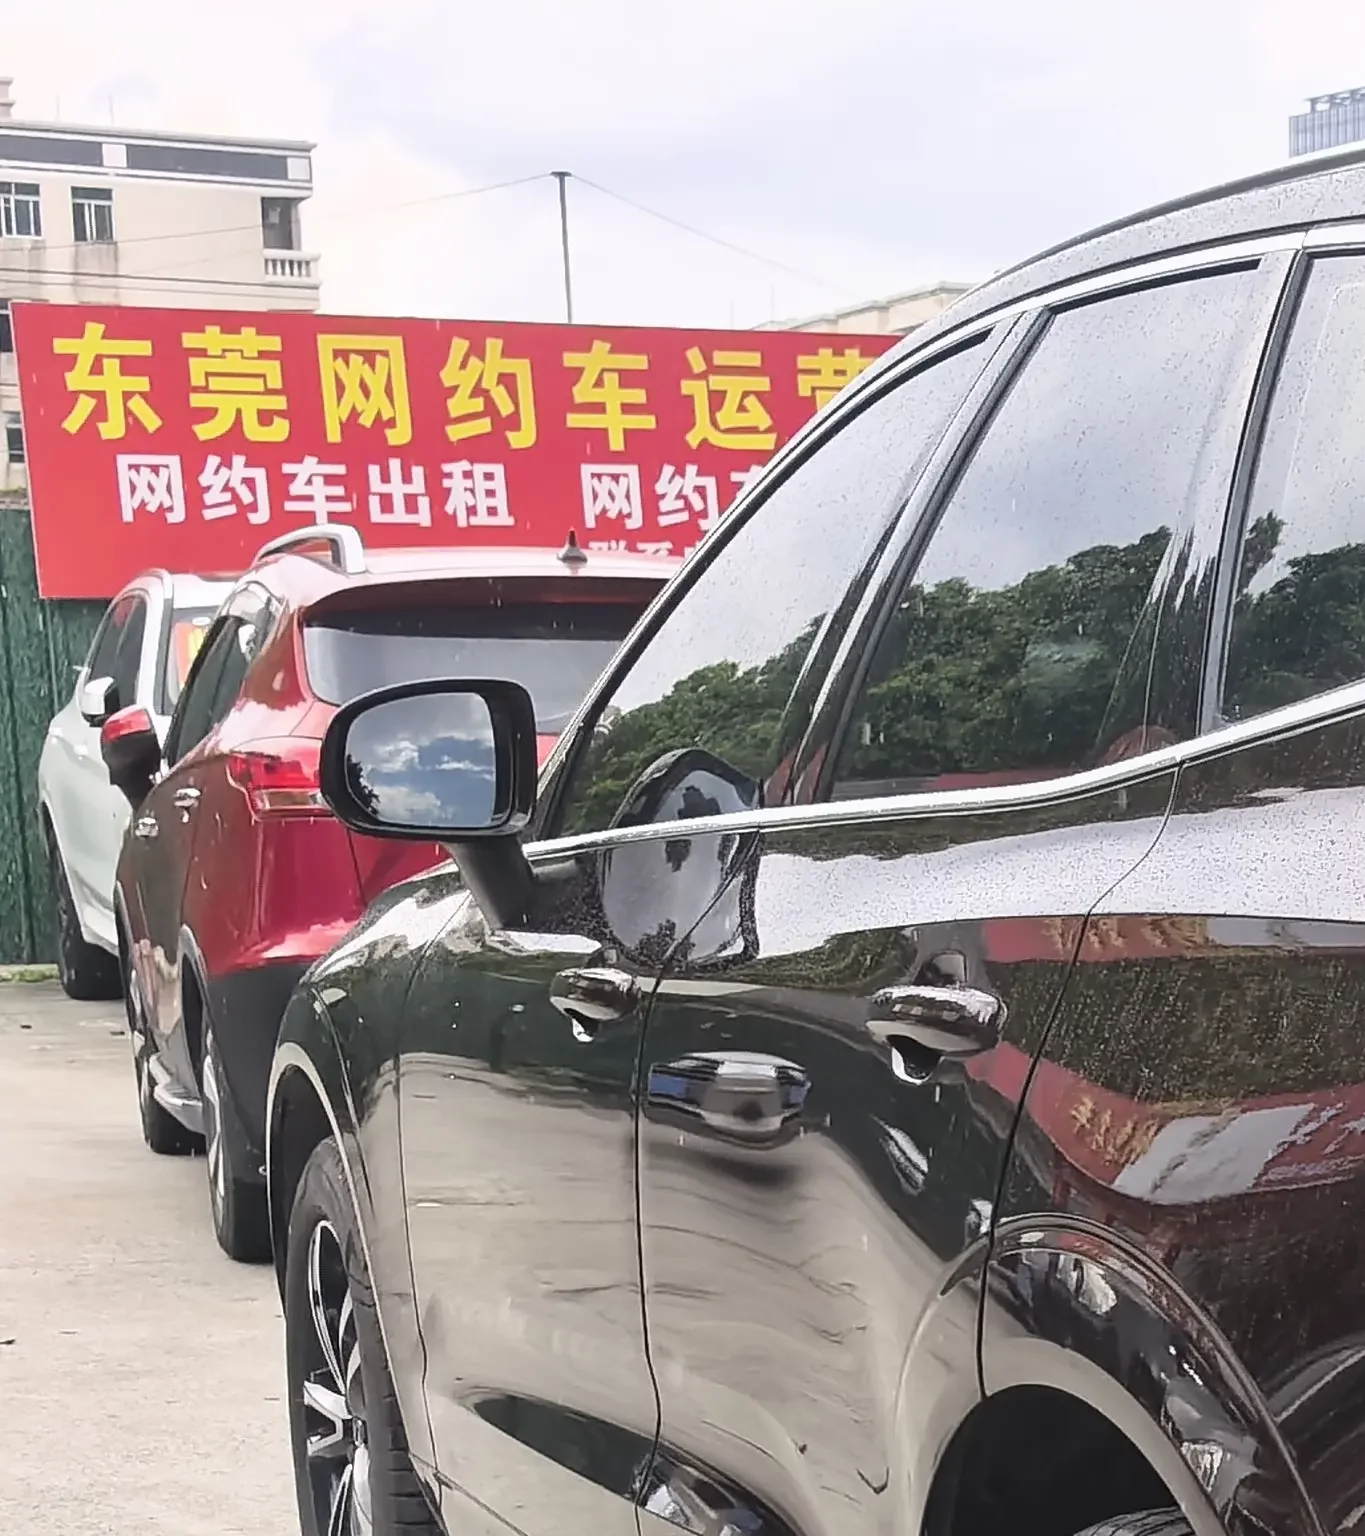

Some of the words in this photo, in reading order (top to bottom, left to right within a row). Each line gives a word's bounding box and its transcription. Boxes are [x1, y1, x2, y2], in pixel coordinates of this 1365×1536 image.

[116, 455, 515, 529] 网约车出租
